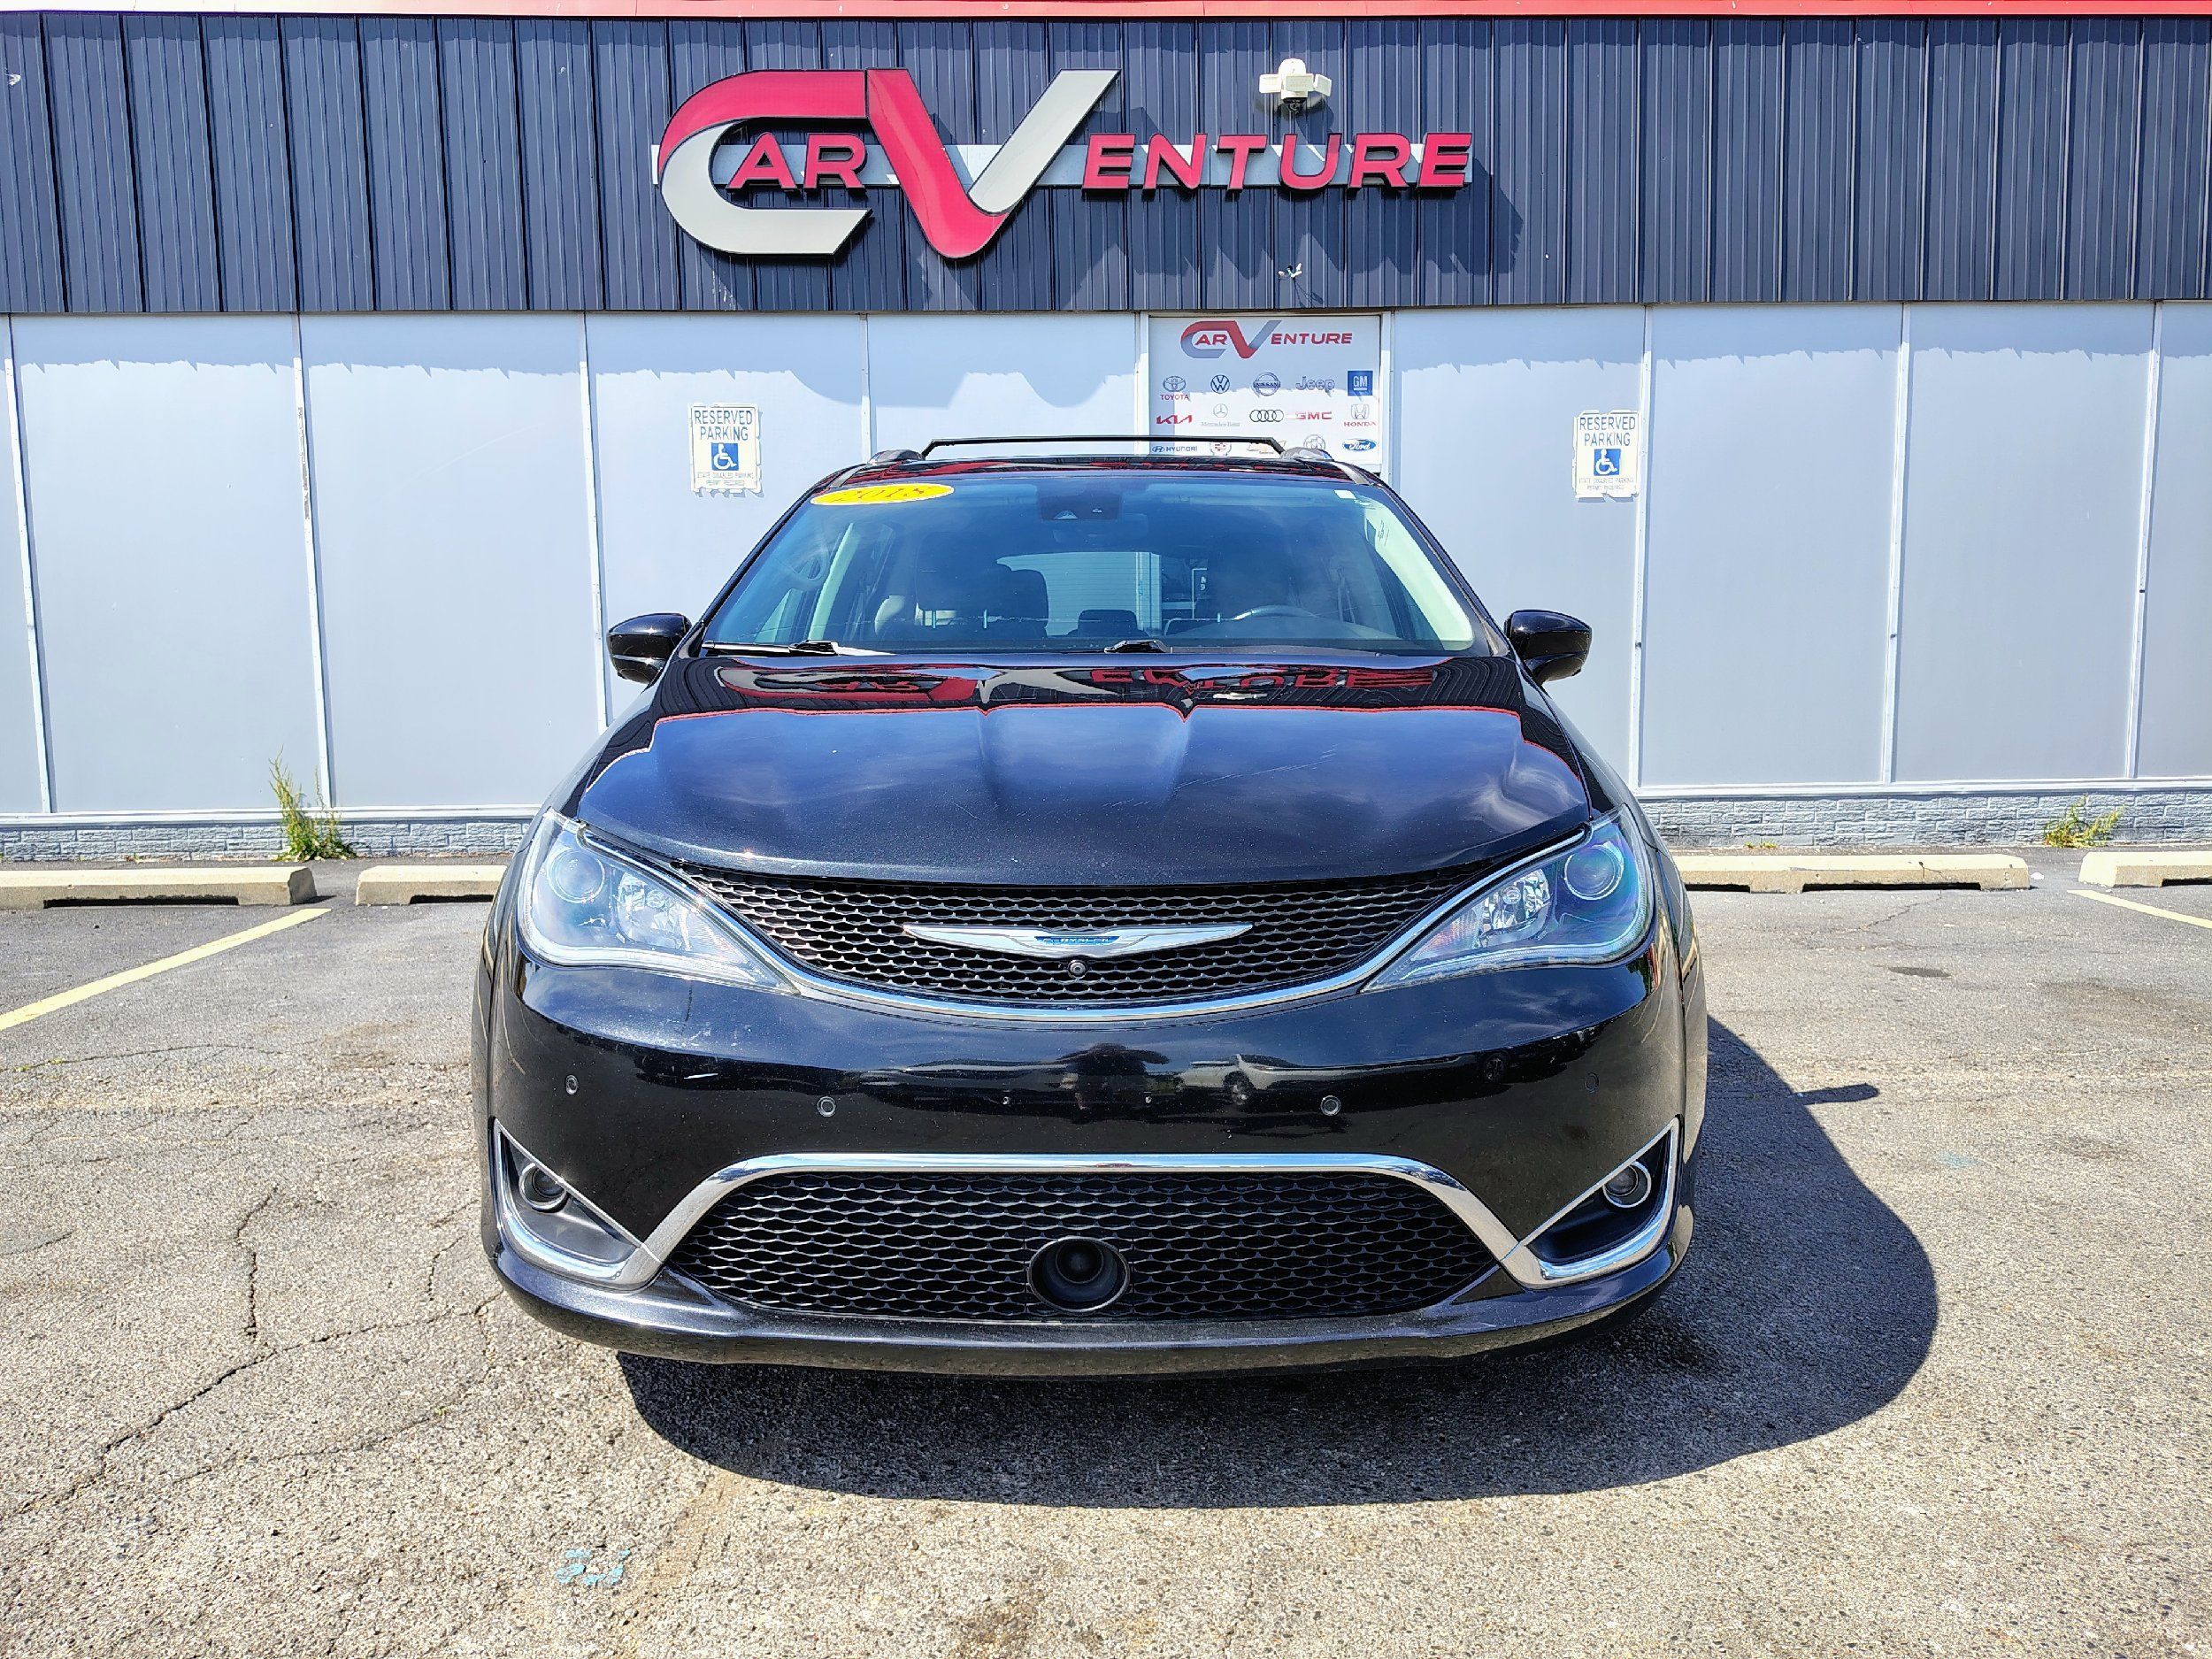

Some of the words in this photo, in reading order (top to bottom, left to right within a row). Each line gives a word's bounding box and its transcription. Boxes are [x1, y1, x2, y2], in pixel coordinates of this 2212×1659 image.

[1296, 376, 1335, 391] Jeep
[1353, 376, 1368, 387] GM
[694, 410, 753, 425] RESERVED
[1579, 416, 1636, 430] RESERVED
[700, 426, 749, 441] PARKING
[1585, 433, 1631, 446] PARKING
